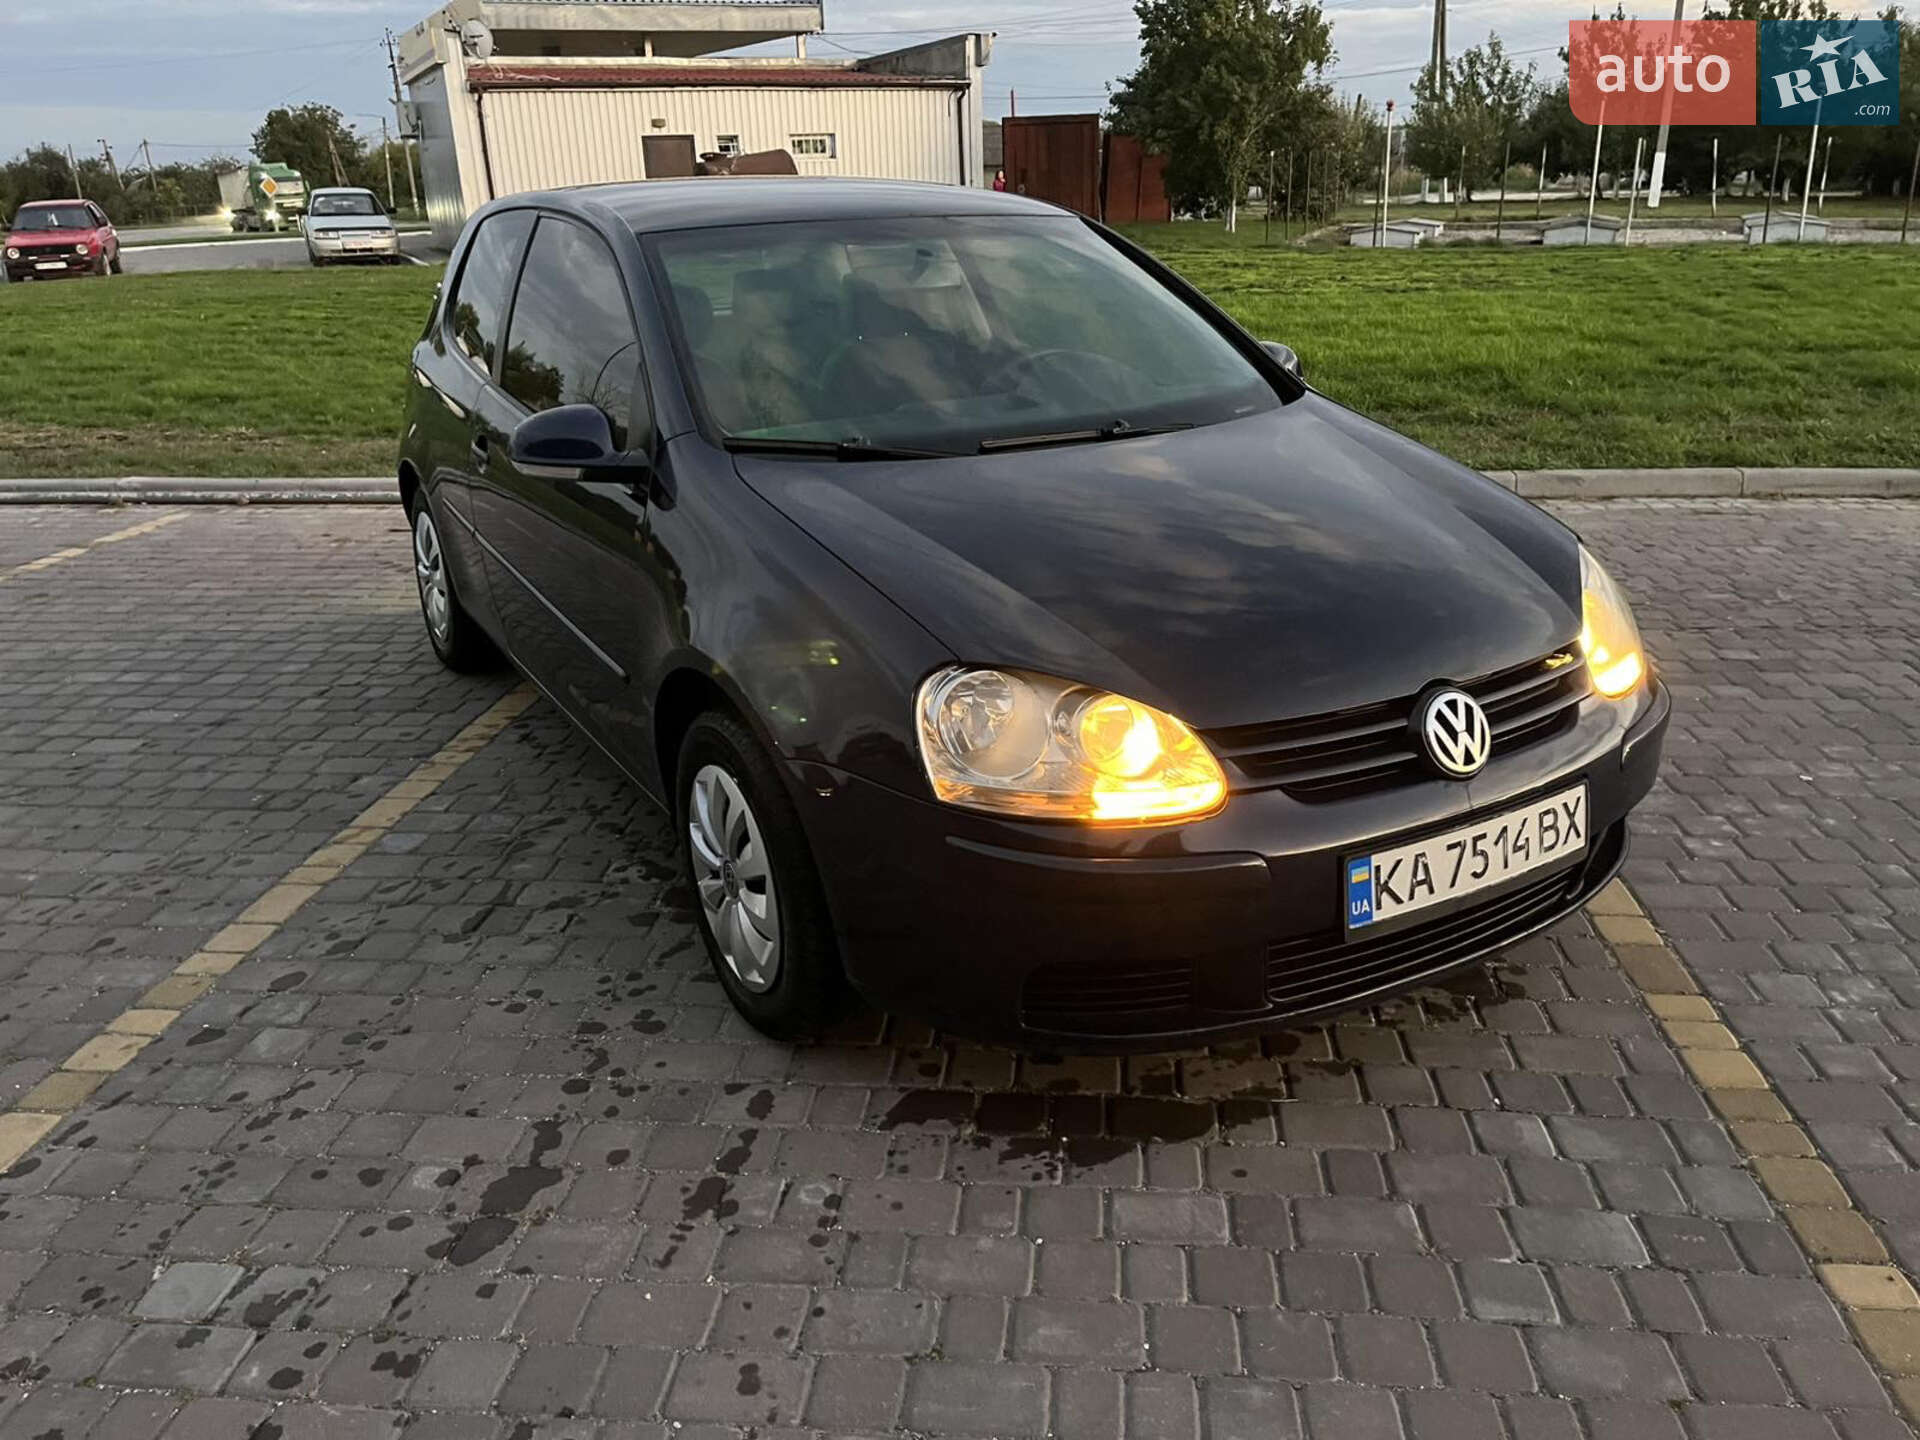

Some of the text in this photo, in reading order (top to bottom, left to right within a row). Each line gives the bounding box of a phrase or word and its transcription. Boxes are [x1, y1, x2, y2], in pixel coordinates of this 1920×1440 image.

[1374, 796, 1582, 911] KA 7514 BX
[1352, 899, 1370, 915] UA
